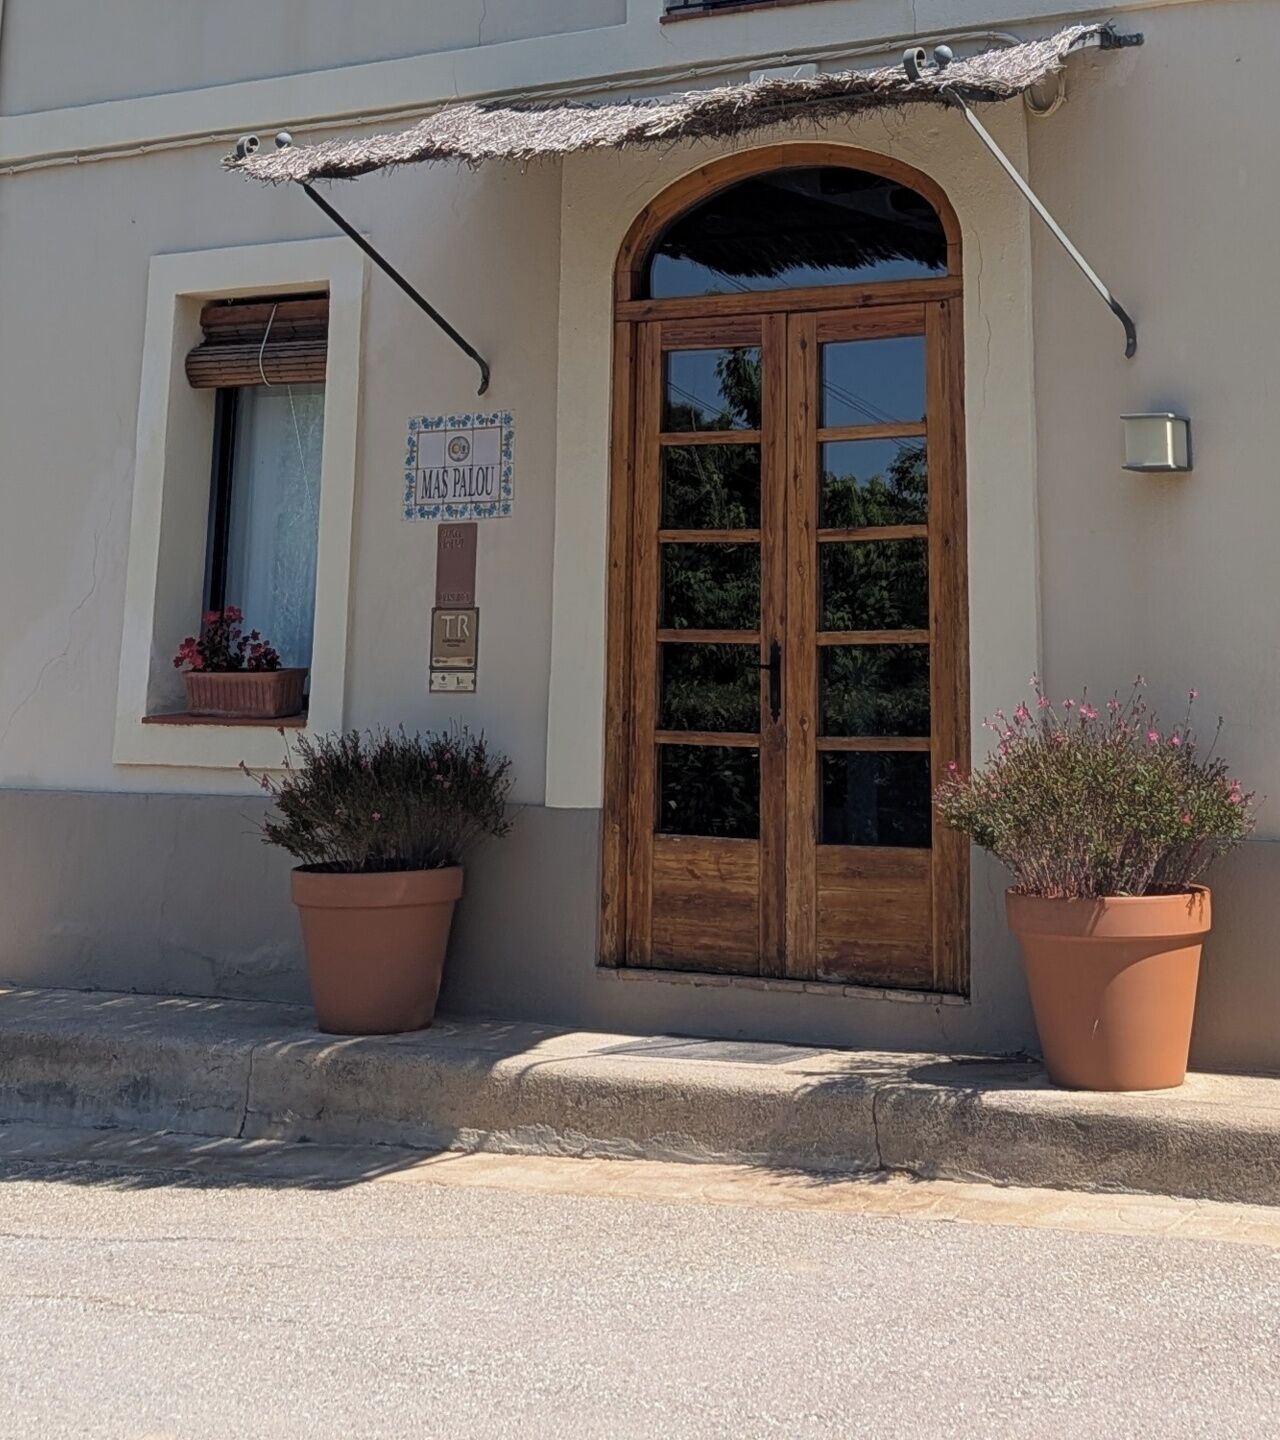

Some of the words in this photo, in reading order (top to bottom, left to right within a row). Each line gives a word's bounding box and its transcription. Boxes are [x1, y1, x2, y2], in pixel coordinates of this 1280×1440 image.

[421, 468, 448, 499] MAS
[452, 466, 494, 498] PALOU
[441, 615, 470, 638] TR
